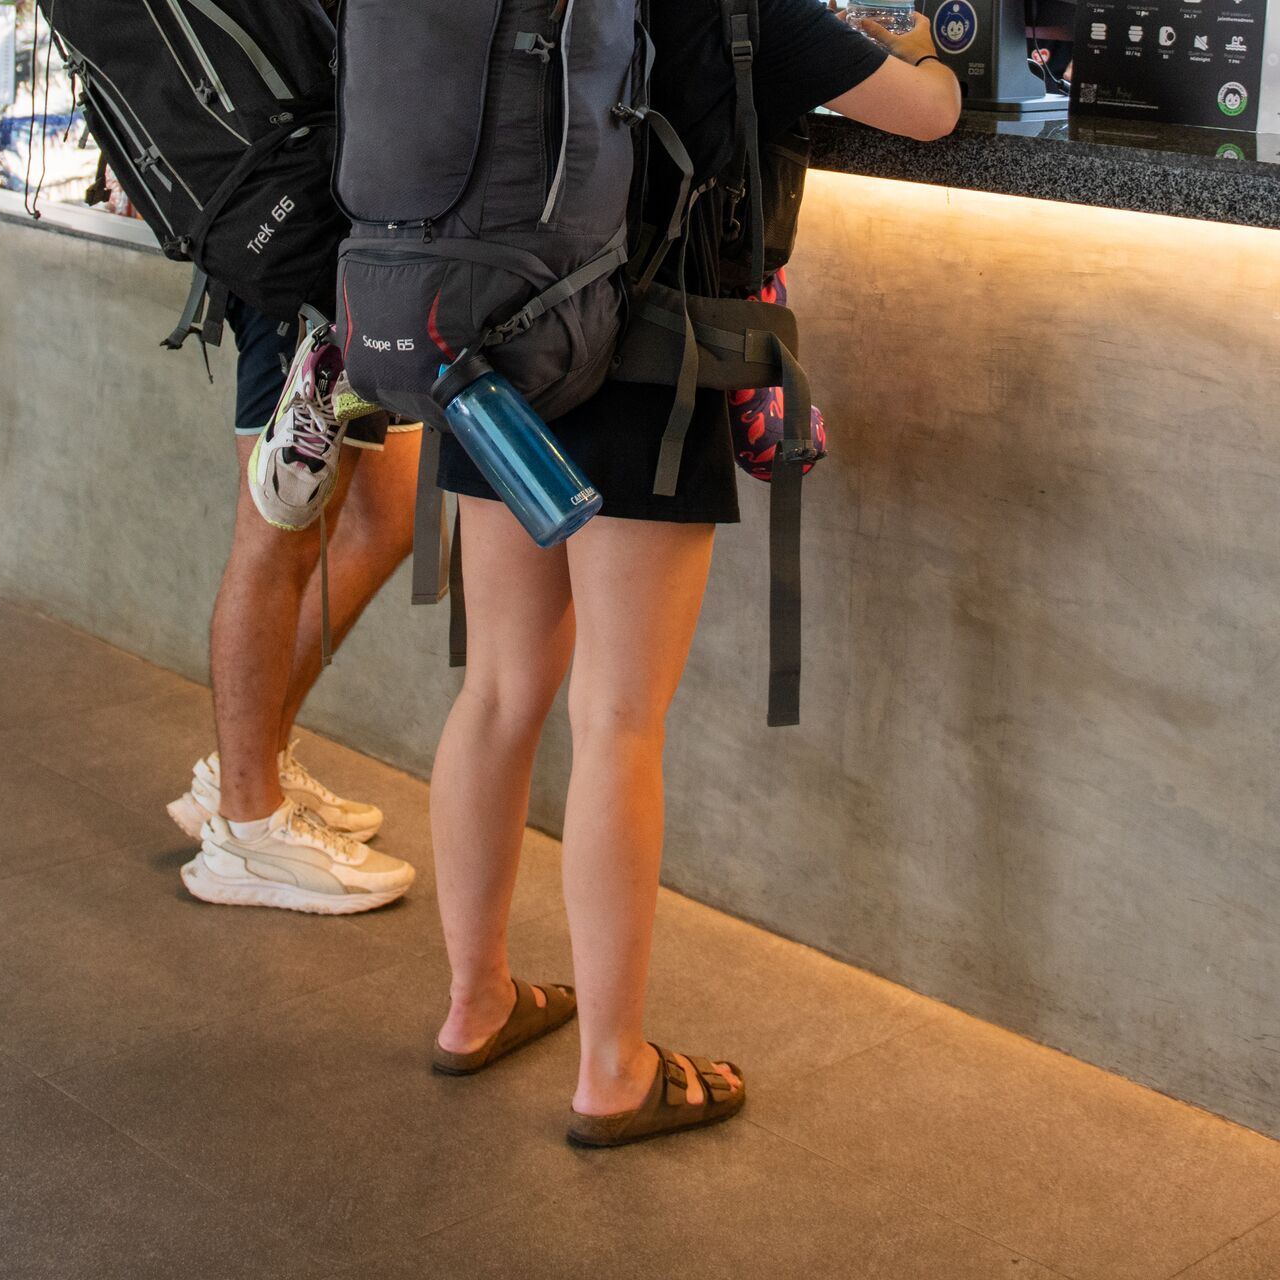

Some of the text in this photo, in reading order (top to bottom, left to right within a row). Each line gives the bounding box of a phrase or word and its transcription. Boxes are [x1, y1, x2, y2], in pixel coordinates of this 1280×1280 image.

[247, 195, 295, 254] Trek 66
[363, 335, 414, 352] Scope 65
